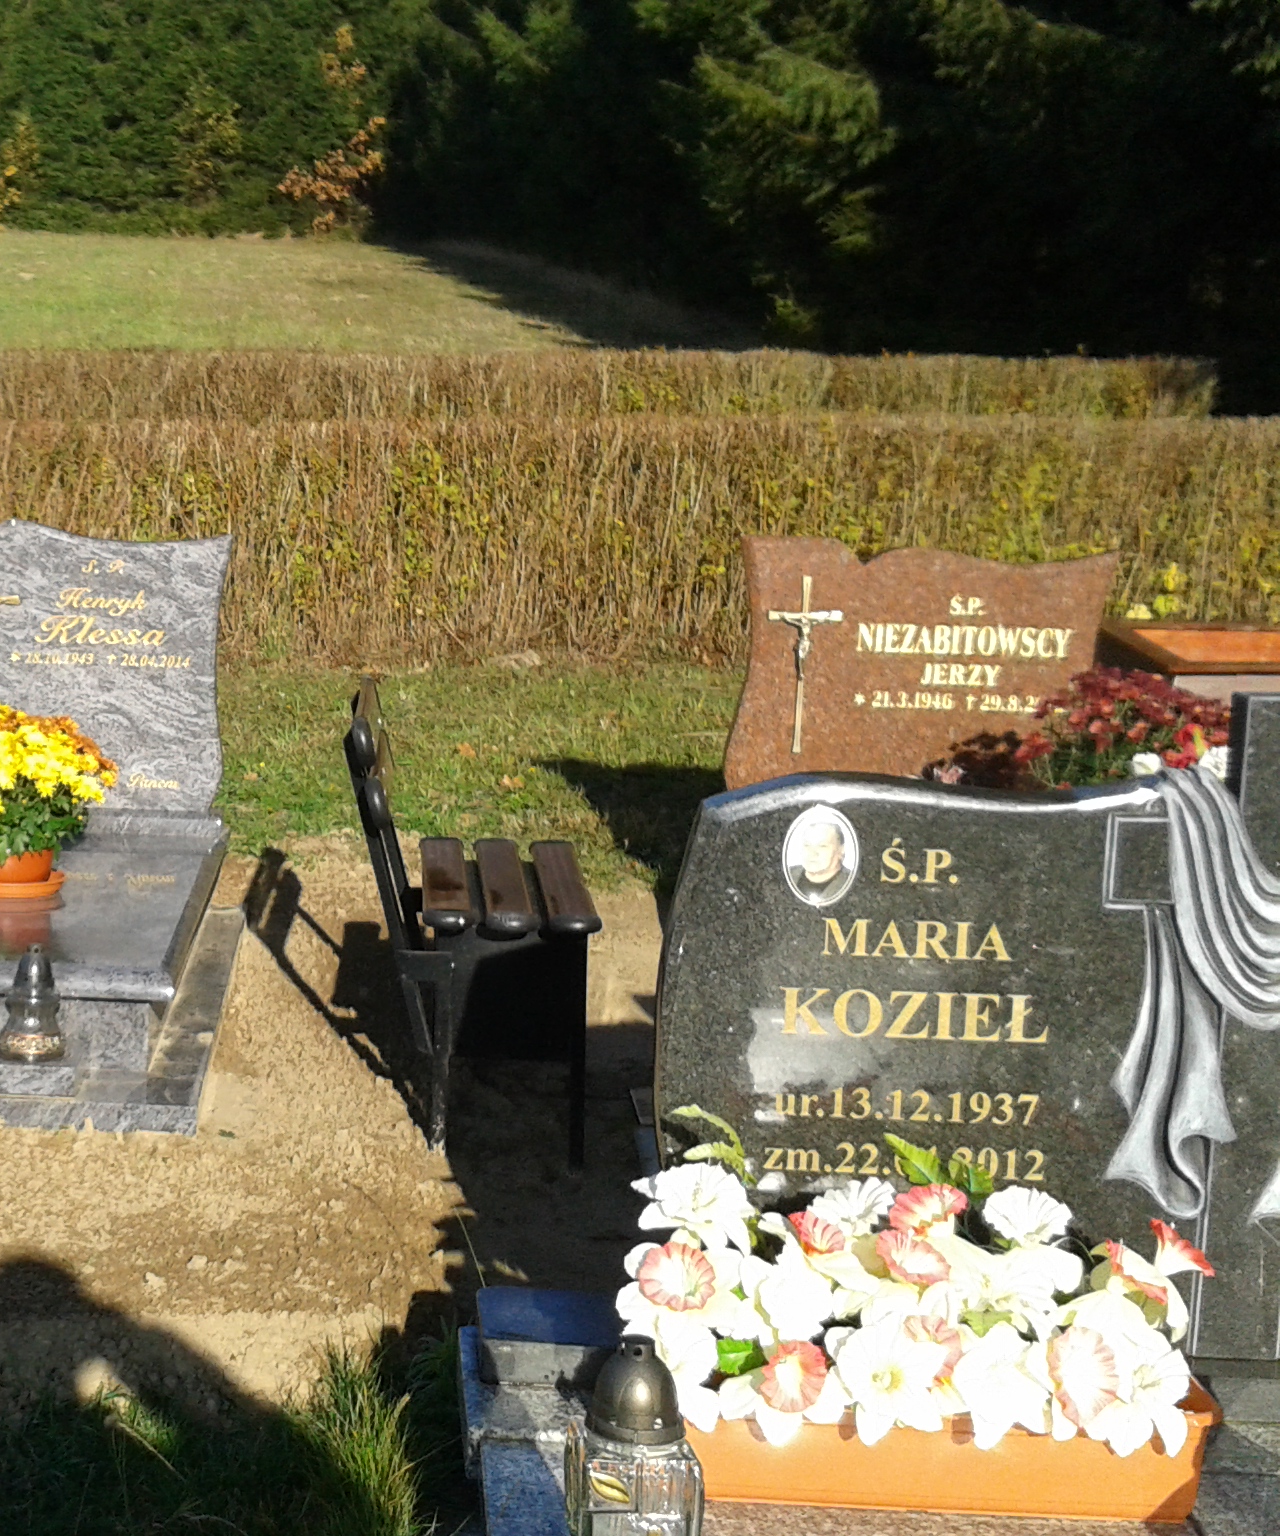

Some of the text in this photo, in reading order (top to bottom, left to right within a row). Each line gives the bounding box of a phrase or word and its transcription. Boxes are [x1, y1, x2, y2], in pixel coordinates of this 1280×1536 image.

[56, 587, 148, 617] Henryk
[34, 615, 168, 646] Klessa
[856, 623, 1073, 658] NIEZABITOWSCY
[921, 662, 1001, 687] JERZY
[880, 837, 959, 884] Ś.P.
[821, 917, 1013, 962] MARIA
[779, 986, 1050, 1044] KOZIEŁ
[775, 1087, 1040, 1126] ur.13.12.1937
